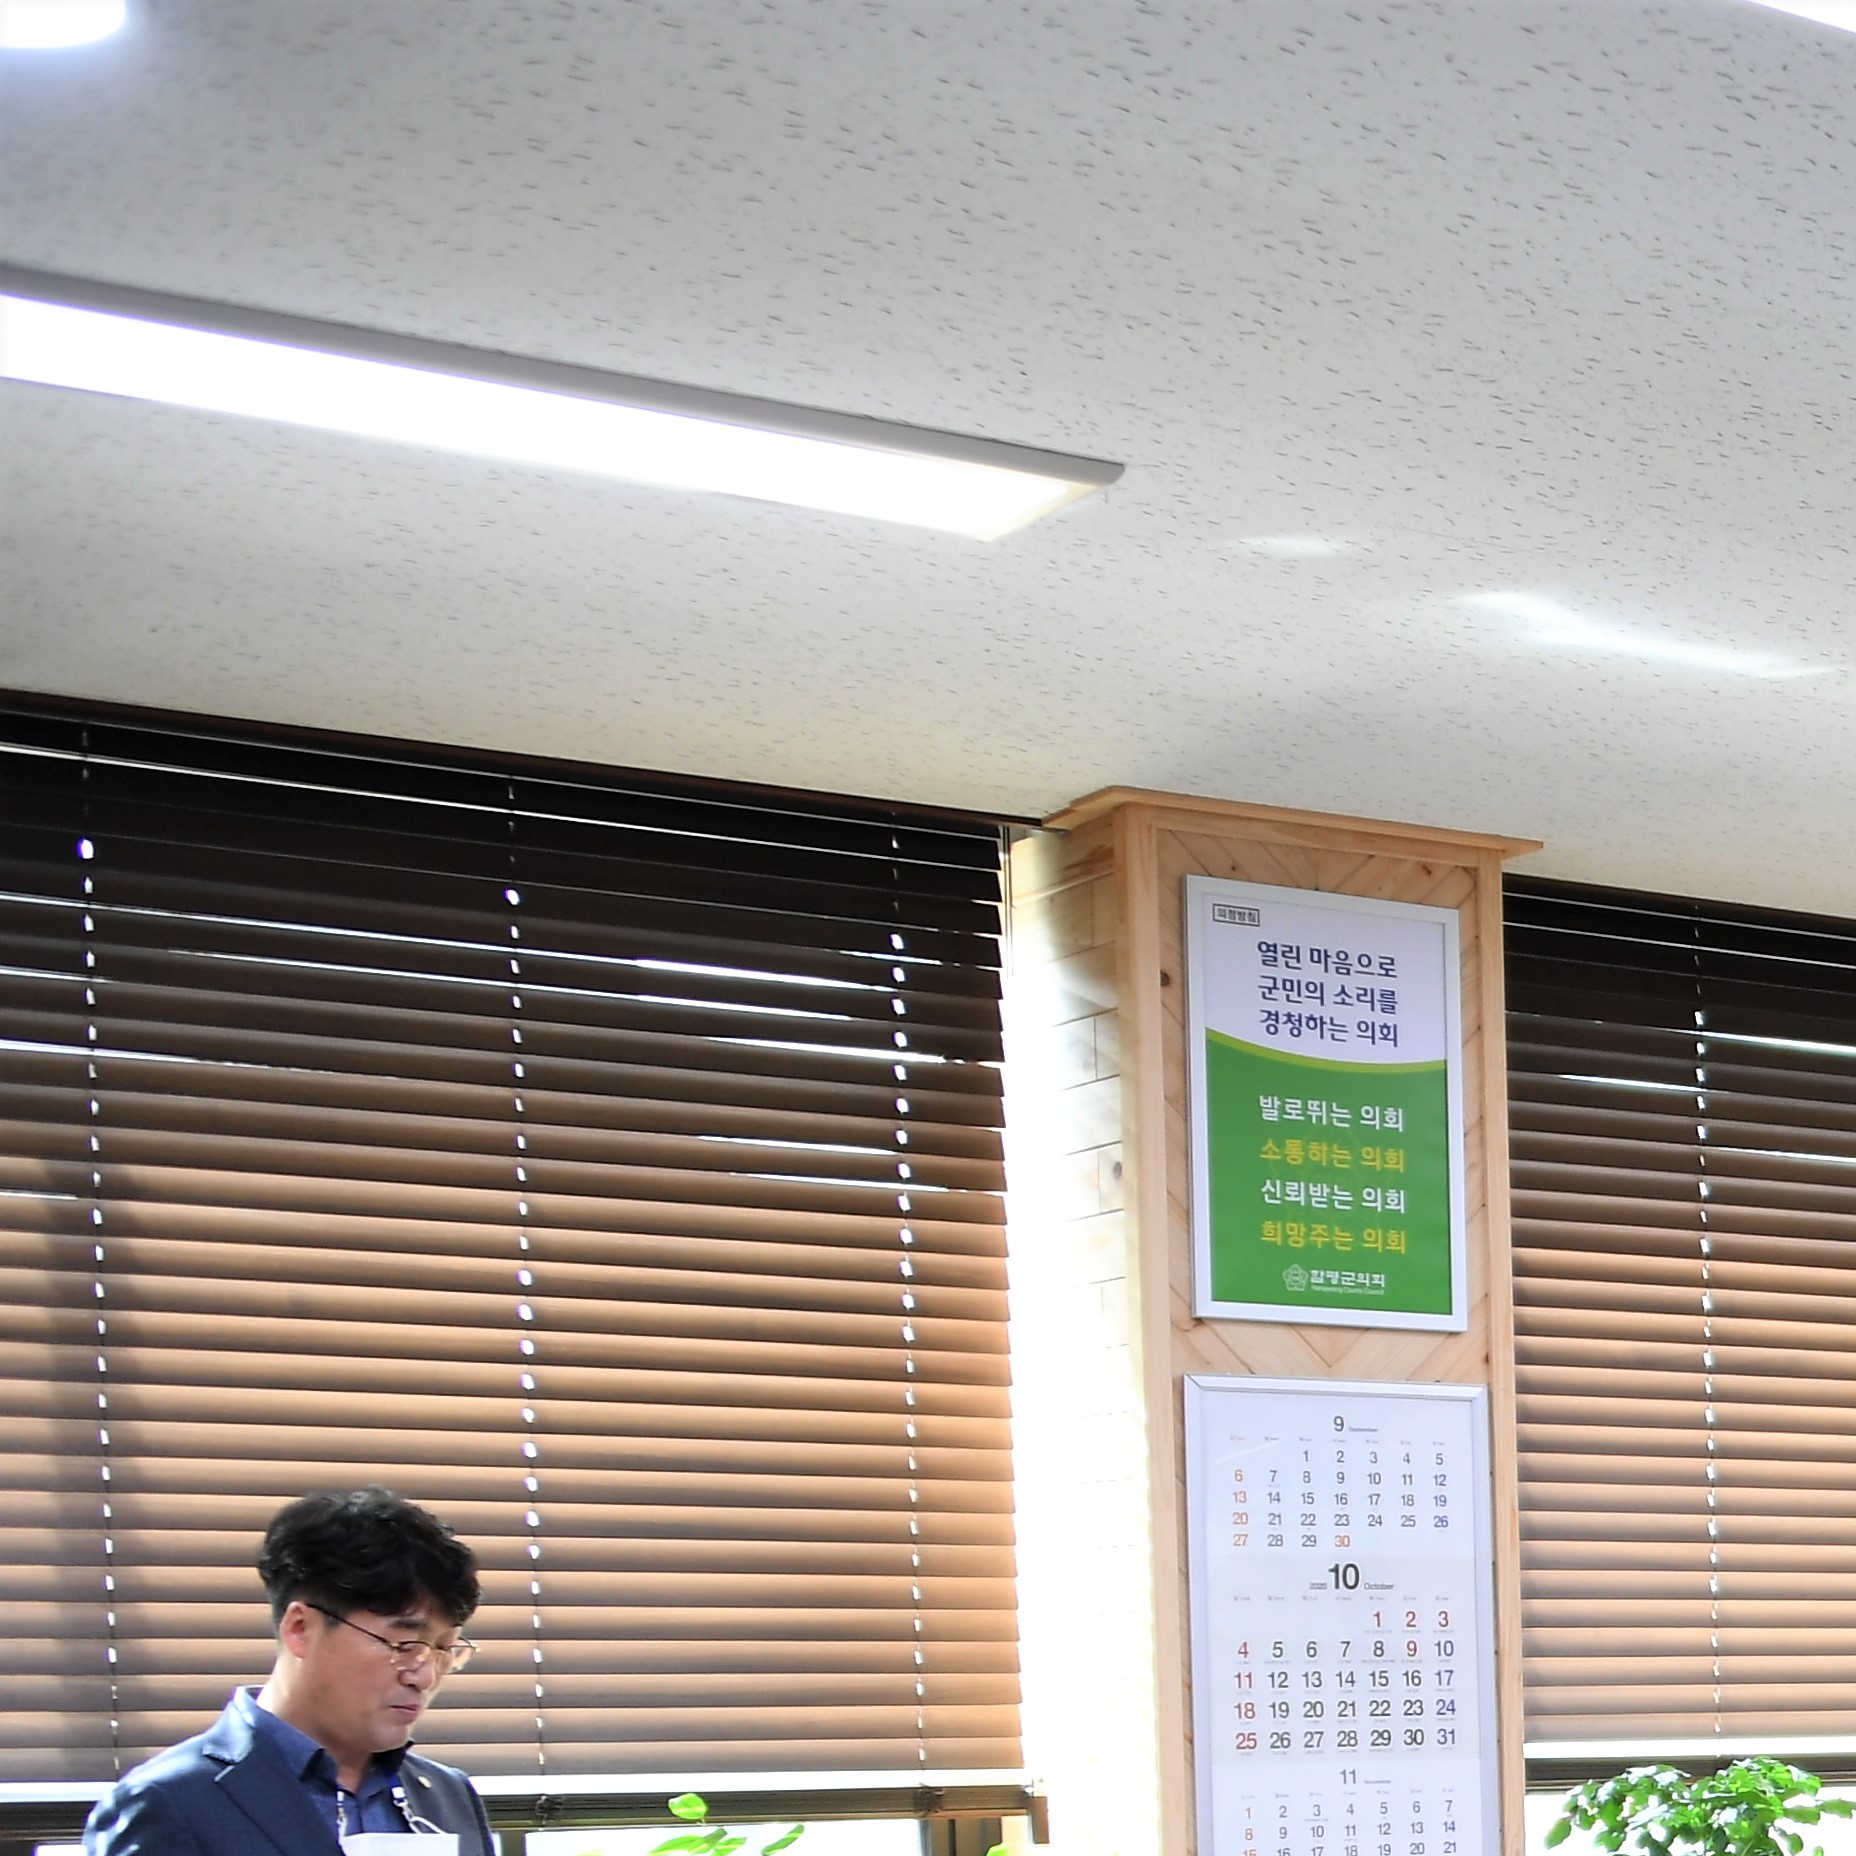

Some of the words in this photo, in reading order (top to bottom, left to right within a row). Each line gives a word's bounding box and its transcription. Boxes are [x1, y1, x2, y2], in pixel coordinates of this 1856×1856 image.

[1257, 941, 1302, 970] 열린
[1309, 947, 1398, 978] 마음으로
[1258, 975, 1325, 1006] 군민의
[1333, 984, 1398, 1015] 소리를
[1259, 1009, 1349, 1042] 경청하는
[1356, 1020, 1398, 1048] 의회
[1259, 1095, 1352, 1127] 발로뛰는
[1359, 1105, 1403, 1132] 의회
[1260, 1138, 1352, 1168] 소통하는
[1360, 1146, 1404, 1173] 의회
[1261, 1179, 1354, 1210] 신뢰받는
[1361, 1187, 1405, 1214] 의회
[1261, 1220, 1354, 1251] 희망주는
[1362, 1228, 1406, 1254] 의회
[1333, 1415, 1345, 1433] 9
[1302, 1449, 1309, 1463] 1
[1336, 1450, 1345, 1464] 2
[1369, 1451, 1379, 1465] 3
[1402, 1452, 1411, 1465] 4
[1435, 1452, 1444, 1466] 5
[1234, 1468, 1244, 1483] 6
[1269, 1469, 1278, 1483] 7
[1302, 1470, 1312, 1484] 8
[1336, 1471, 1345, 1485] 9
[1367, 1471, 1382, 1485] 10
[1401, 1473, 1413, 1486] 11
[1433, 1473, 1447, 1487] 12
[1232, 1490, 1248, 1504] 13
[1267, 1491, 1281, 1504] 14
[1300, 1491, 1315, 1505] 15
[1334, 1492, 1348, 1506] 16
[1367, 1493, 1381, 1506] 17
[1400, 1493, 1415, 1507] 18
[1433, 1494, 1448, 1508] 19
[1232, 1511, 1249, 1526] 20
[1267, 1512, 1282, 1526] 21
[1300, 1513, 1317, 1527] 22
[1333, 1513, 1351, 1527] 23
[1367, 1514, 1383, 1528] 24
[1400, 1514, 1417, 1528] 25
[1433, 1515, 1449, 1528] 26
[1233, 1533, 1249, 1547] 27
[1267, 1533, 1284, 1548] 28
[1301, 1534, 1318, 1548] 29
[1334, 1534, 1351, 1548] 30
[1328, 1563, 1360, 1591] 10
[1363, 1582, 1395, 1590] October
[1373, 1611, 1381, 1628] 1
[1405, 1610, 1417, 1628] 2
[1438, 1610, 1449, 1628] 3
[1237, 1641, 1250, 1659] 4
[1272, 1640, 1284, 1659] 5
[1306, 1640, 1318, 1658] 6
[1340, 1640, 1351, 1658] 7
[1373, 1640, 1385, 1658] 8
[1406, 1640, 1418, 1658] 9
[1434, 1639, 1455, 1657] 10
[1234, 1671, 1253, 1689] 11
[1267, 1671, 1289, 1689] 12
[1301, 1670, 1323, 1688] 13
[1335, 1670, 1356, 1688] 14
[1368, 1669, 1390, 1687] 15
[1401, 1669, 1422, 1687] 16
[1434, 1669, 1454, 1686] 17
[1233, 1701, 1256, 1720] 18
[1268, 1701, 1290, 1719] 19
[1302, 1700, 1325, 1719] 20
[1337, 1700, 1356, 1718] 21
[1368, 1699, 1392, 1717] 22
[1403, 1699, 1424, 1717] 23
[1435, 1698, 1457, 1716] 24
[1235, 1732, 1258, 1750] 25
[1269, 1731, 1292, 1750] 26
[1303, 1730, 1325, 1749] 27
[1336, 1729, 1359, 1748] 28
[1370, 1729, 1392, 1747] 29
[1403, 1728, 1425, 1746] 30
[1436, 1728, 1456, 1746] 31
[1339, 1768, 1357, 1785] 11
[1245, 1806, 1251, 1820] 1
[1278, 1805, 1288, 1819] 2
[1312, 1804, 1321, 1817] 3
[1346, 1803, 1355, 1816] 4
[1379, 1801, 1389, 1815] 5
[1412, 1800, 1421, 1814] 6
[1445, 1799, 1453, 1813] 7
[1244, 1827, 1254, 1841] 8
[1278, 1826, 1288, 1840] 9
[1310, 1824, 1325, 1838] 10
[1344, 1824, 1356, 1837] 11
[1378, 1822, 1391, 1836] 12
[1410, 1821, 1424, 1835] 13
[1443, 1820, 1456, 1833] 14
[1377, 1843, 1392, 1856] 19
[1409, 1841, 1426, 1856] 20
[1443, 1841, 1457, 1854] 21
